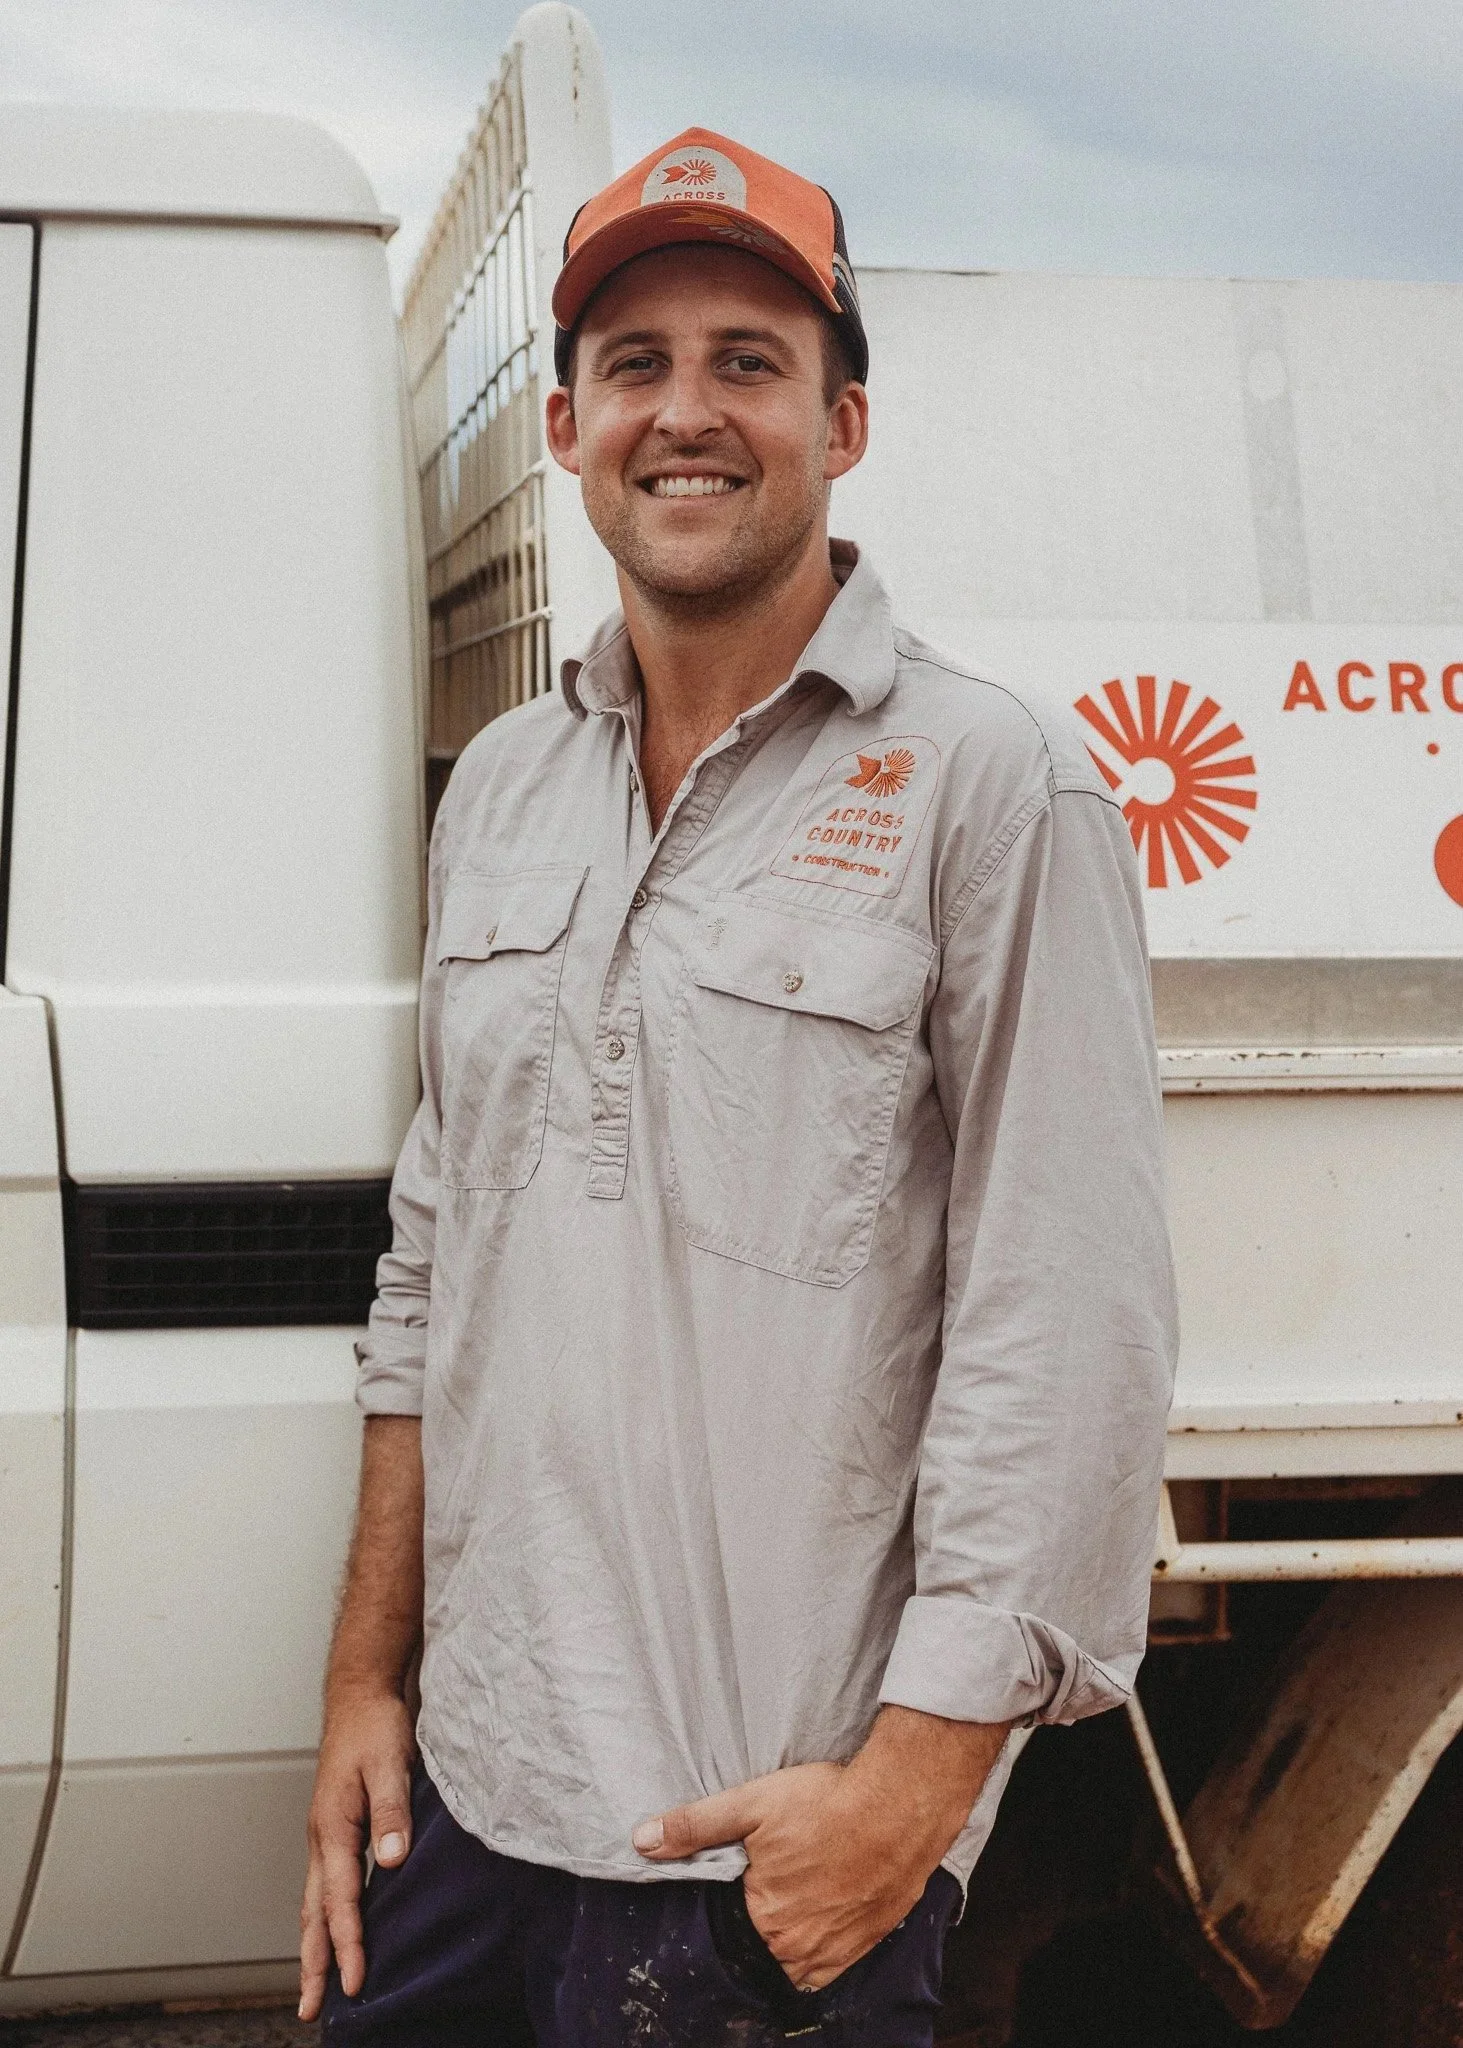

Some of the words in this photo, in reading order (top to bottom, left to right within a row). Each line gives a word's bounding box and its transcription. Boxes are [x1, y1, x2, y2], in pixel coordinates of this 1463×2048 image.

[826, 807, 905, 830] ACROSS
[806, 825, 903, 853] COUNTRY
[803, 855, 881, 878] CONSTRUCTION
